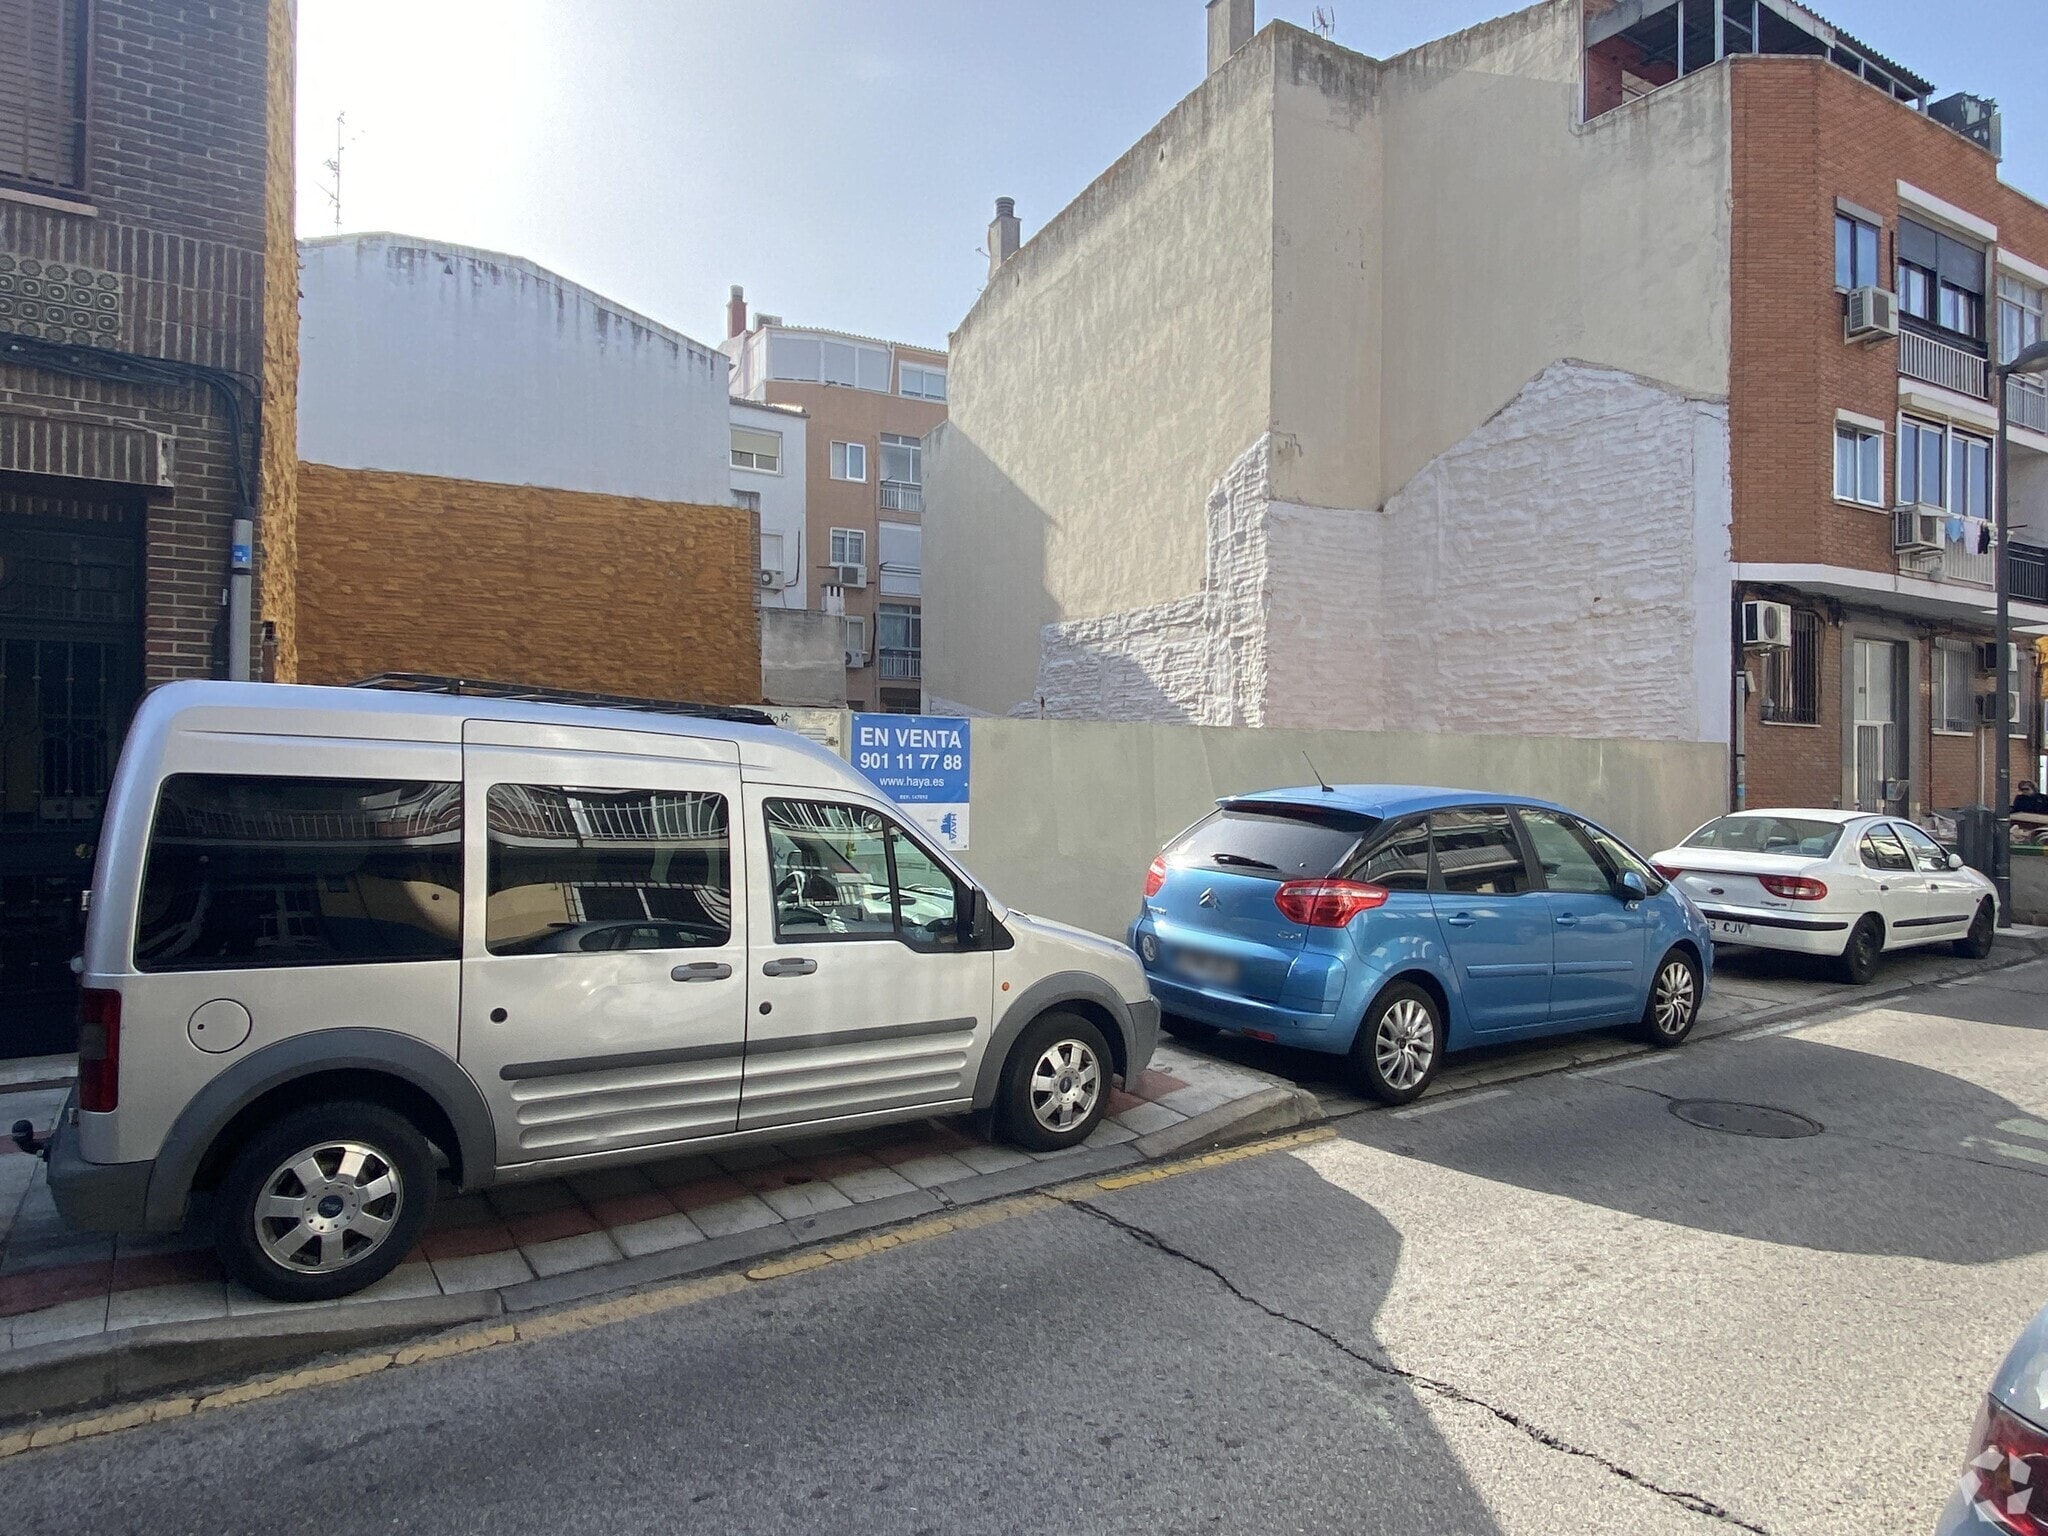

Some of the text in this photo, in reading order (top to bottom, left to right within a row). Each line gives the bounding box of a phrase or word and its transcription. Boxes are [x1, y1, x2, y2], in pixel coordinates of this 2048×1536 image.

[860, 727, 962, 749] EN VENTA
[860, 752, 962, 770] 901 11 77 88
[879, 776, 945, 789] www.haya.es
[950, 813, 958, 840] HAYA
[1723, 922, 1745, 934] CJV
